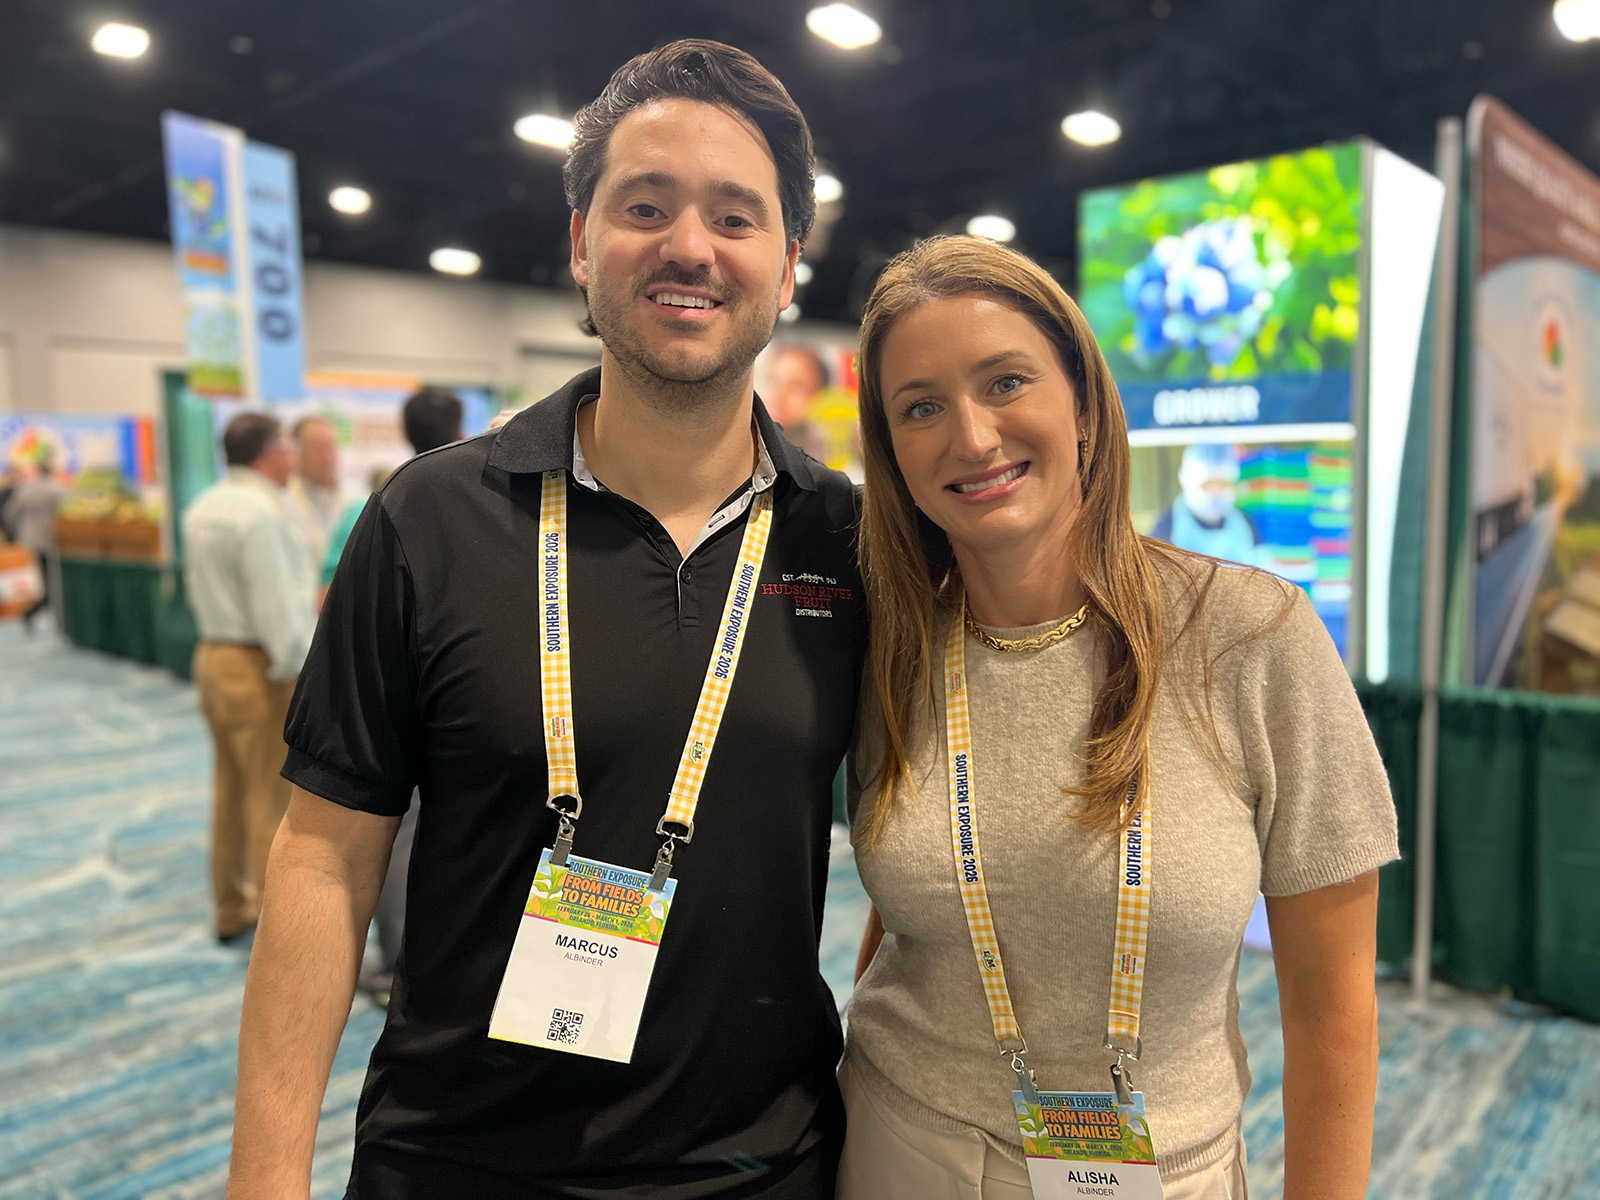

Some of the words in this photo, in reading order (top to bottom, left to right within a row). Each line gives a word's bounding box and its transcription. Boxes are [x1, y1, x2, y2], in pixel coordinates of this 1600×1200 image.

[252, 226, 292, 340] 700
[545, 532, 559, 552] 2026
[545, 554, 559, 600] EXPOSURE
[734, 564, 754, 610] SOUTHERN
[761, 584, 816, 596] HUDSON
[818, 586, 853, 600] RIVER
[794, 596, 832, 608] FRUIT
[796, 608, 832, 618] DISTRIBUTORS
[546, 603, 561, 652] SOUTHERN
[720, 609, 743, 656] EXPOSURE
[715, 654, 731, 680] 2026
[955, 754, 969, 804] SOUTHERN
[958, 805, 973, 858] EXPOSURE
[963, 857, 978, 884] 2026
[1126, 830, 1141, 886] SOUTHERN
[569, 862, 608, 879] SOUTHERN
[608, 871, 647, 888] EXPOSURE
[564, 875, 601, 894] FROM
[602, 884, 643, 904] FIELDS
[562, 888, 579, 903] TO
[579, 892, 640, 918] FAMILIES
[569, 914, 595, 927] ORLANDO,
[596, 922, 618, 931] FLORIDA
[596, 914, 614, 923] MARCH
[555, 934, 618, 958] MARCUS
[564, 952, 604, 966] ALBINDER
[1039, 1096, 1075, 1107] SOUTHERN
[1076, 1097, 1113, 1108] EXPOSURE
[1043, 1110, 1078, 1124] FROM
[1078, 1112, 1118, 1125] FIELDS
[1046, 1123, 1062, 1136] TO
[1064, 1124, 1121, 1140] FAMILIES
[1068, 1170, 1120, 1186] ALISHA
[1077, 1186, 1114, 1196] ALBINDER
